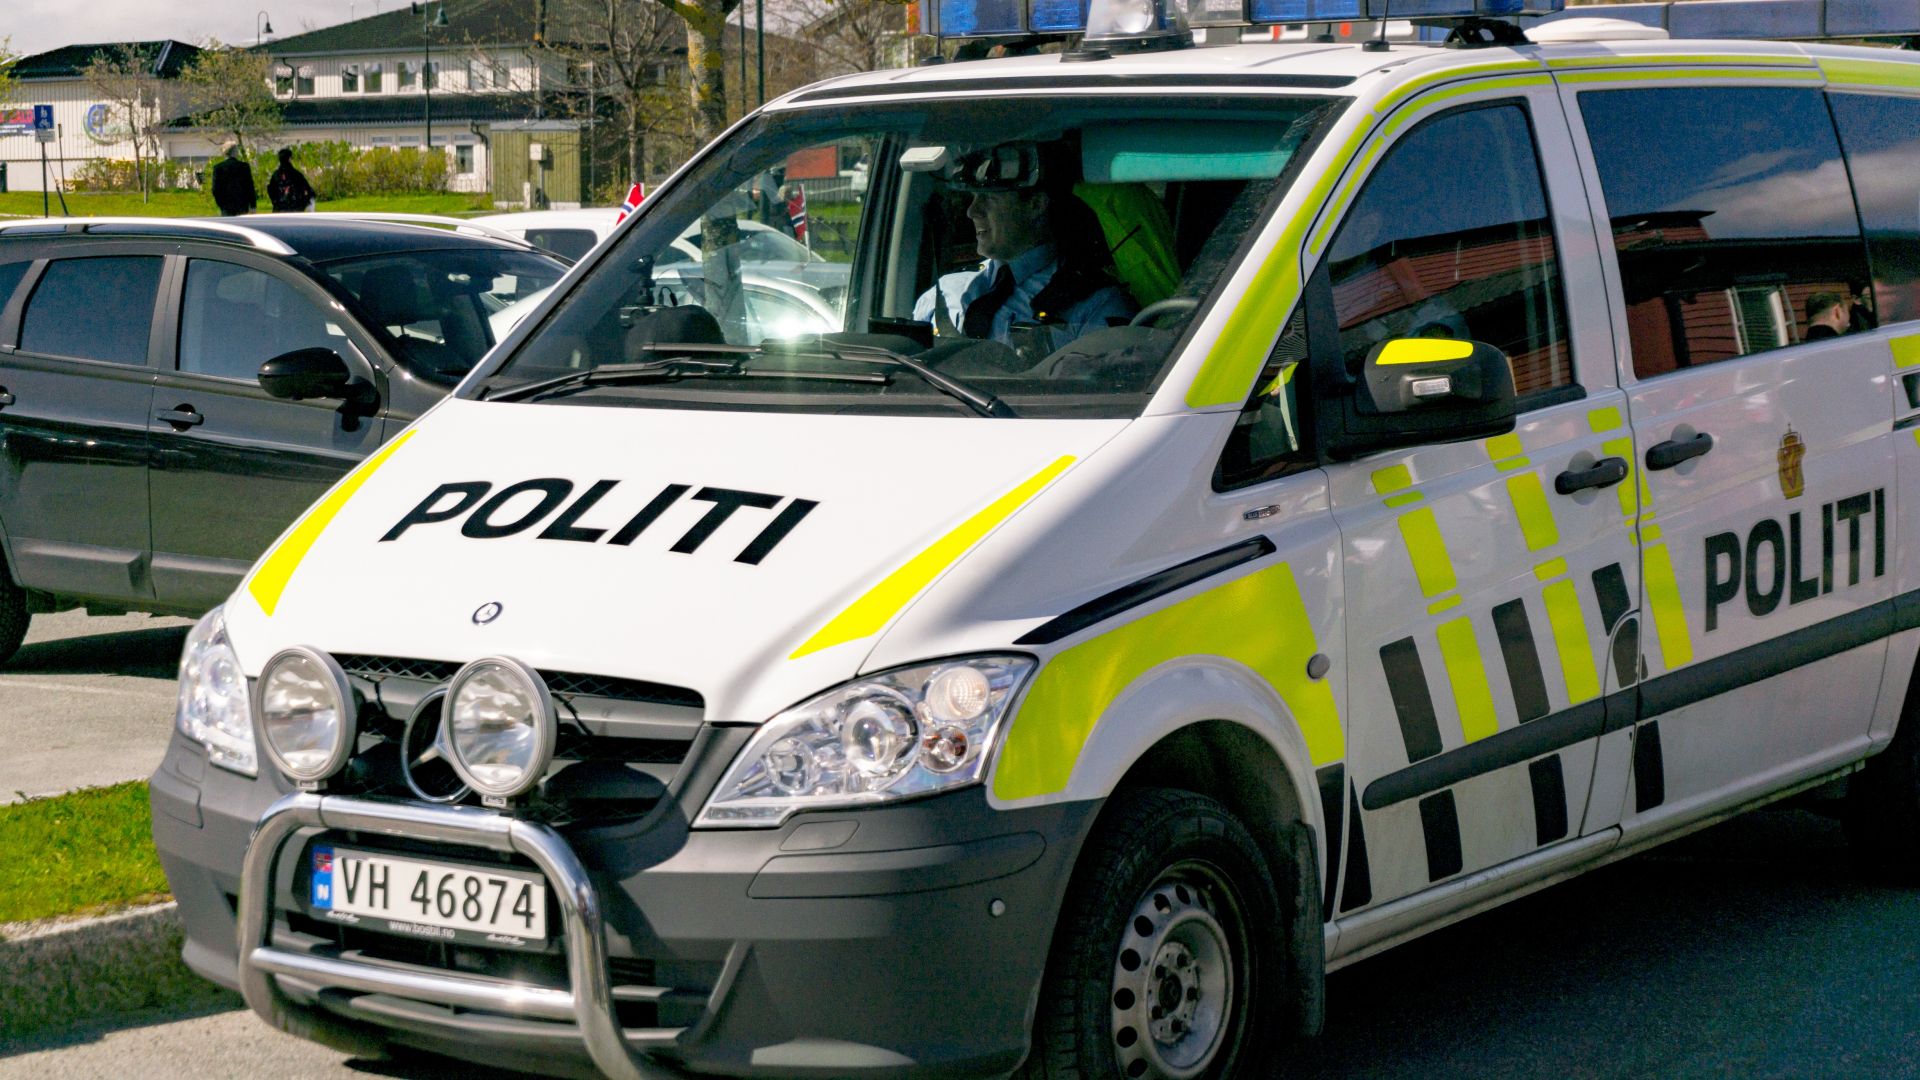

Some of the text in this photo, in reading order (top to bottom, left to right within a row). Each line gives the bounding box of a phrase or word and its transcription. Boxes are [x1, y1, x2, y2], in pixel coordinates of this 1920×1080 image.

[378, 477, 821, 566] POLITI
[1705, 487, 1885, 633] POLITI
[317, 884, 329, 900] N
[341, 857, 536, 929] VH 46874
